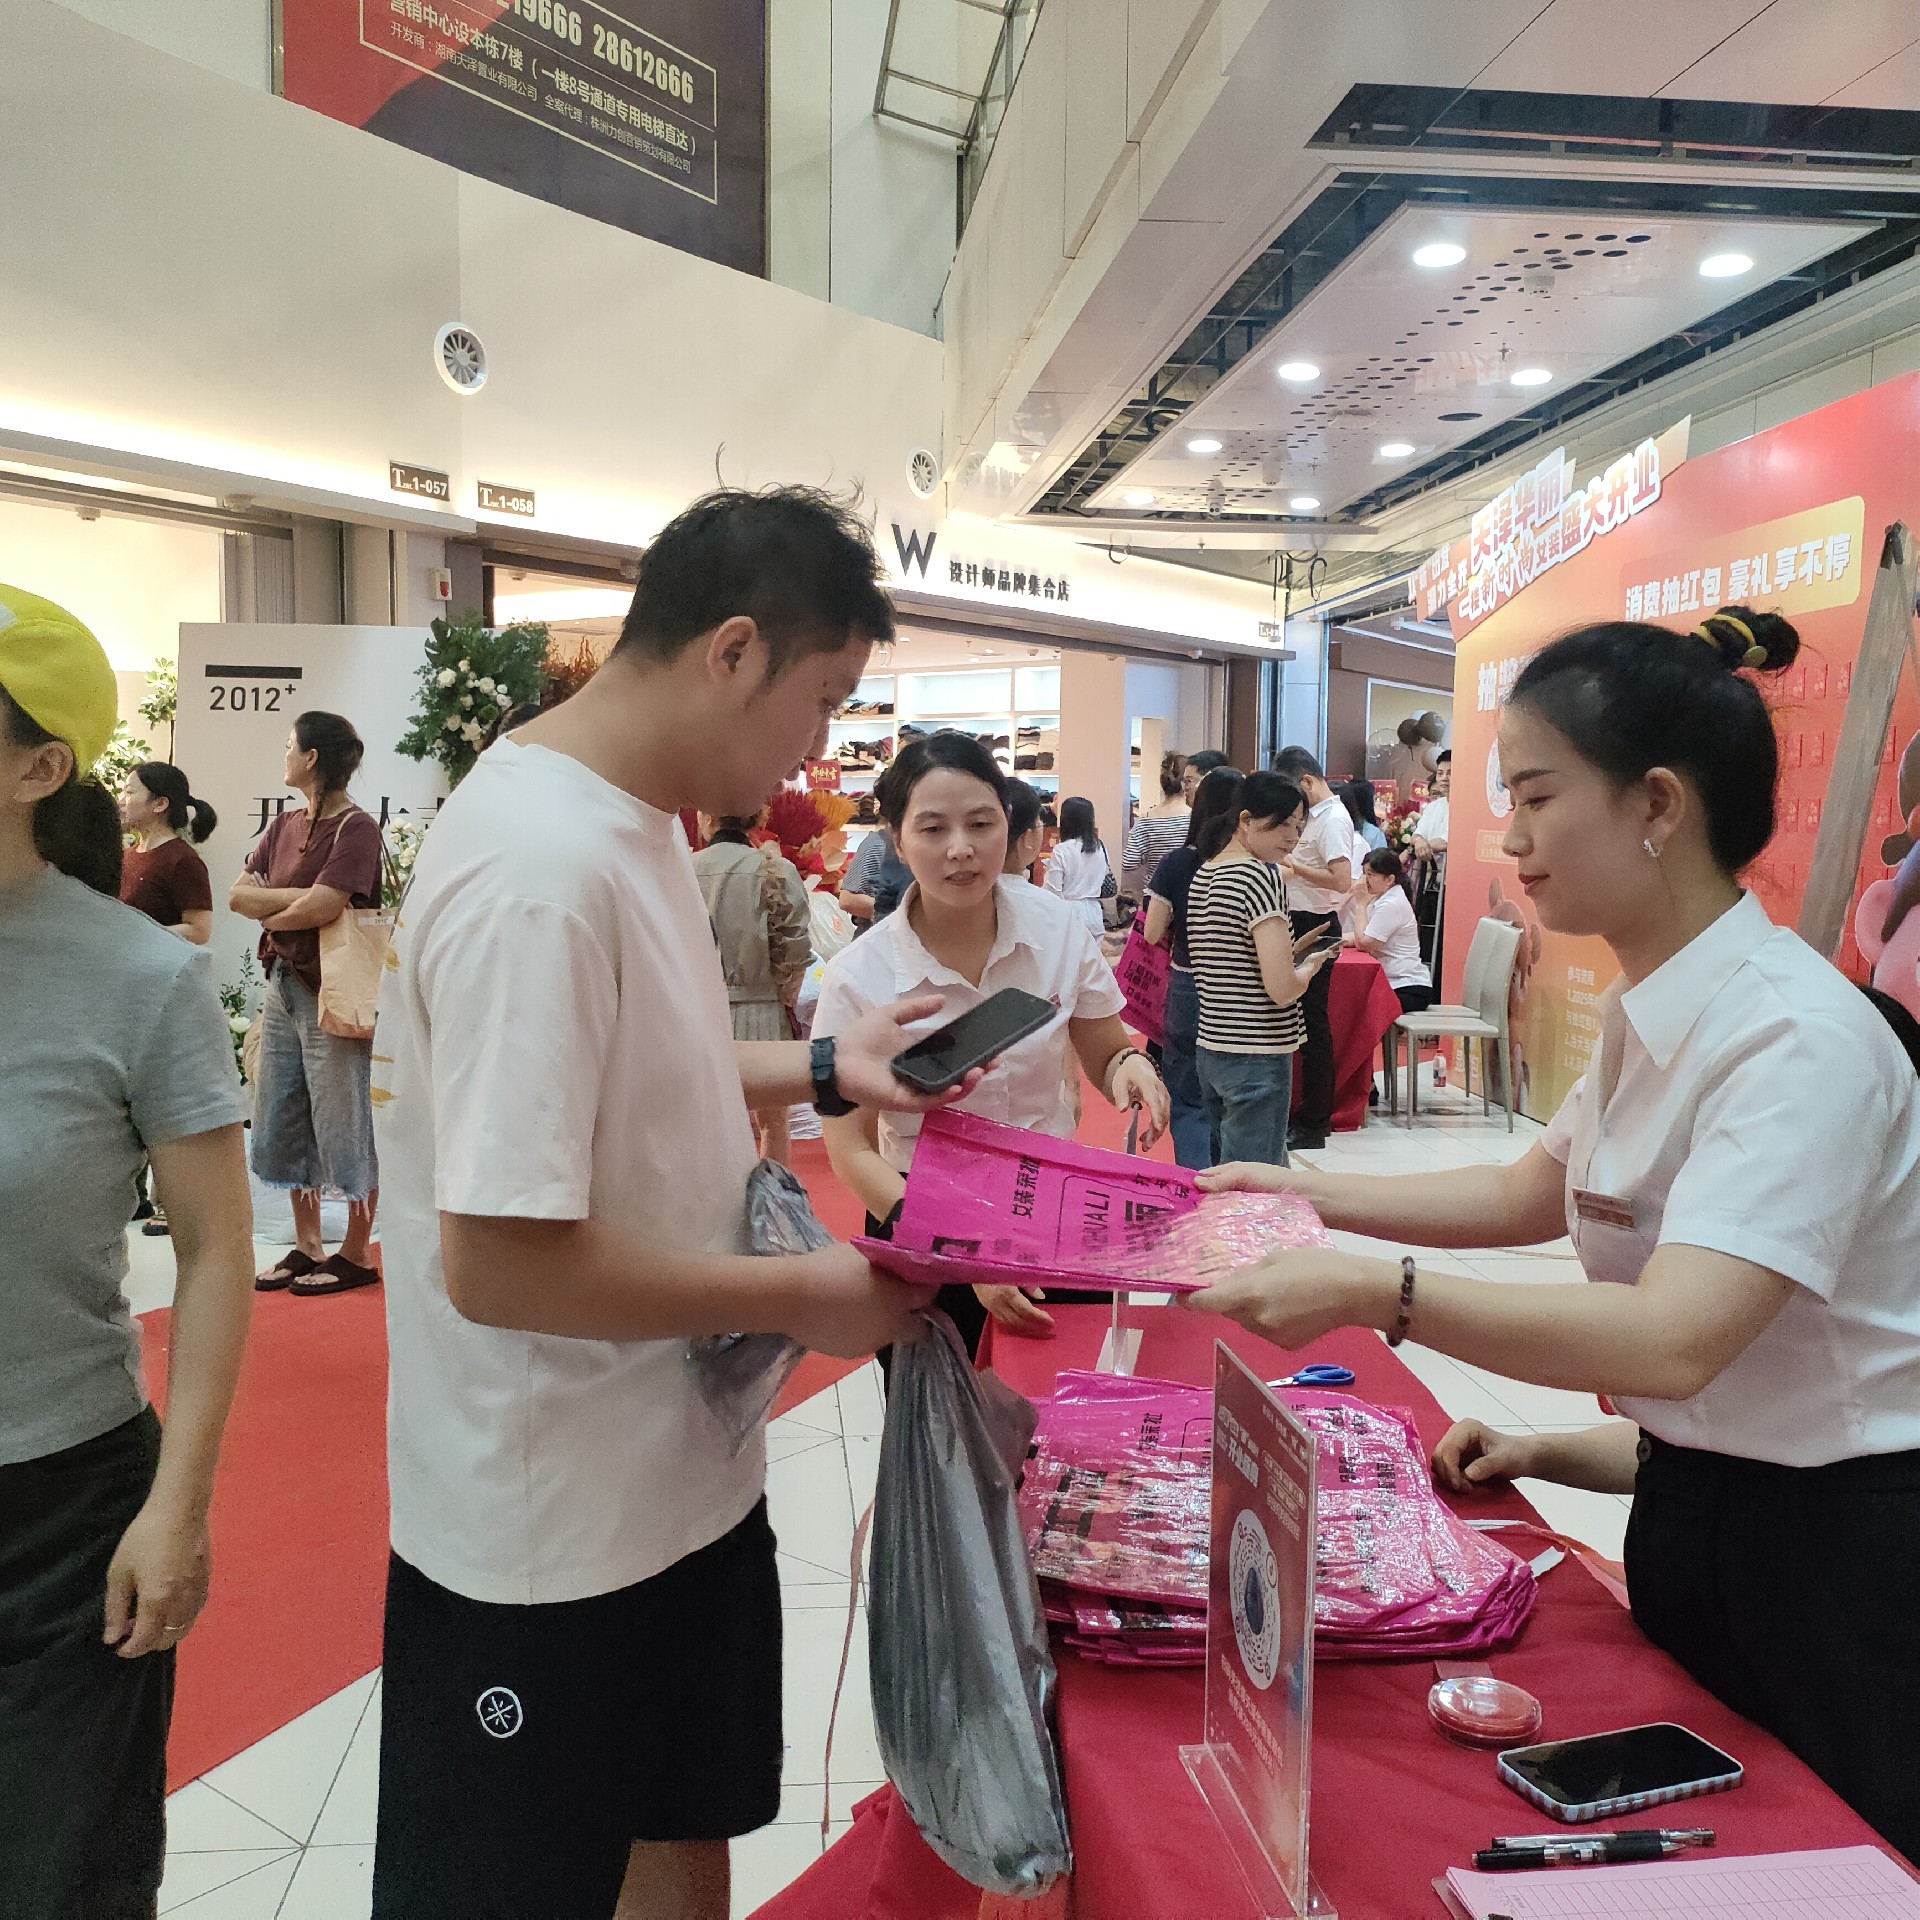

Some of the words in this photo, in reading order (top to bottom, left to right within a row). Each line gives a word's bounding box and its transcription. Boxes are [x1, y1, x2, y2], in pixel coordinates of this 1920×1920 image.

[593, 23, 694, 104] 28612666
[1472, 447, 1564, 572] 天泽华丽
[1561, 438, 1661, 561] 盛大开业
[891, 523, 937, 579] W
[948, 559, 1070, 602] 设计师品牌集合店
[1625, 567, 1722, 622] 消费抽红包
[1727, 533, 1851, 602] 豪礼享不停
